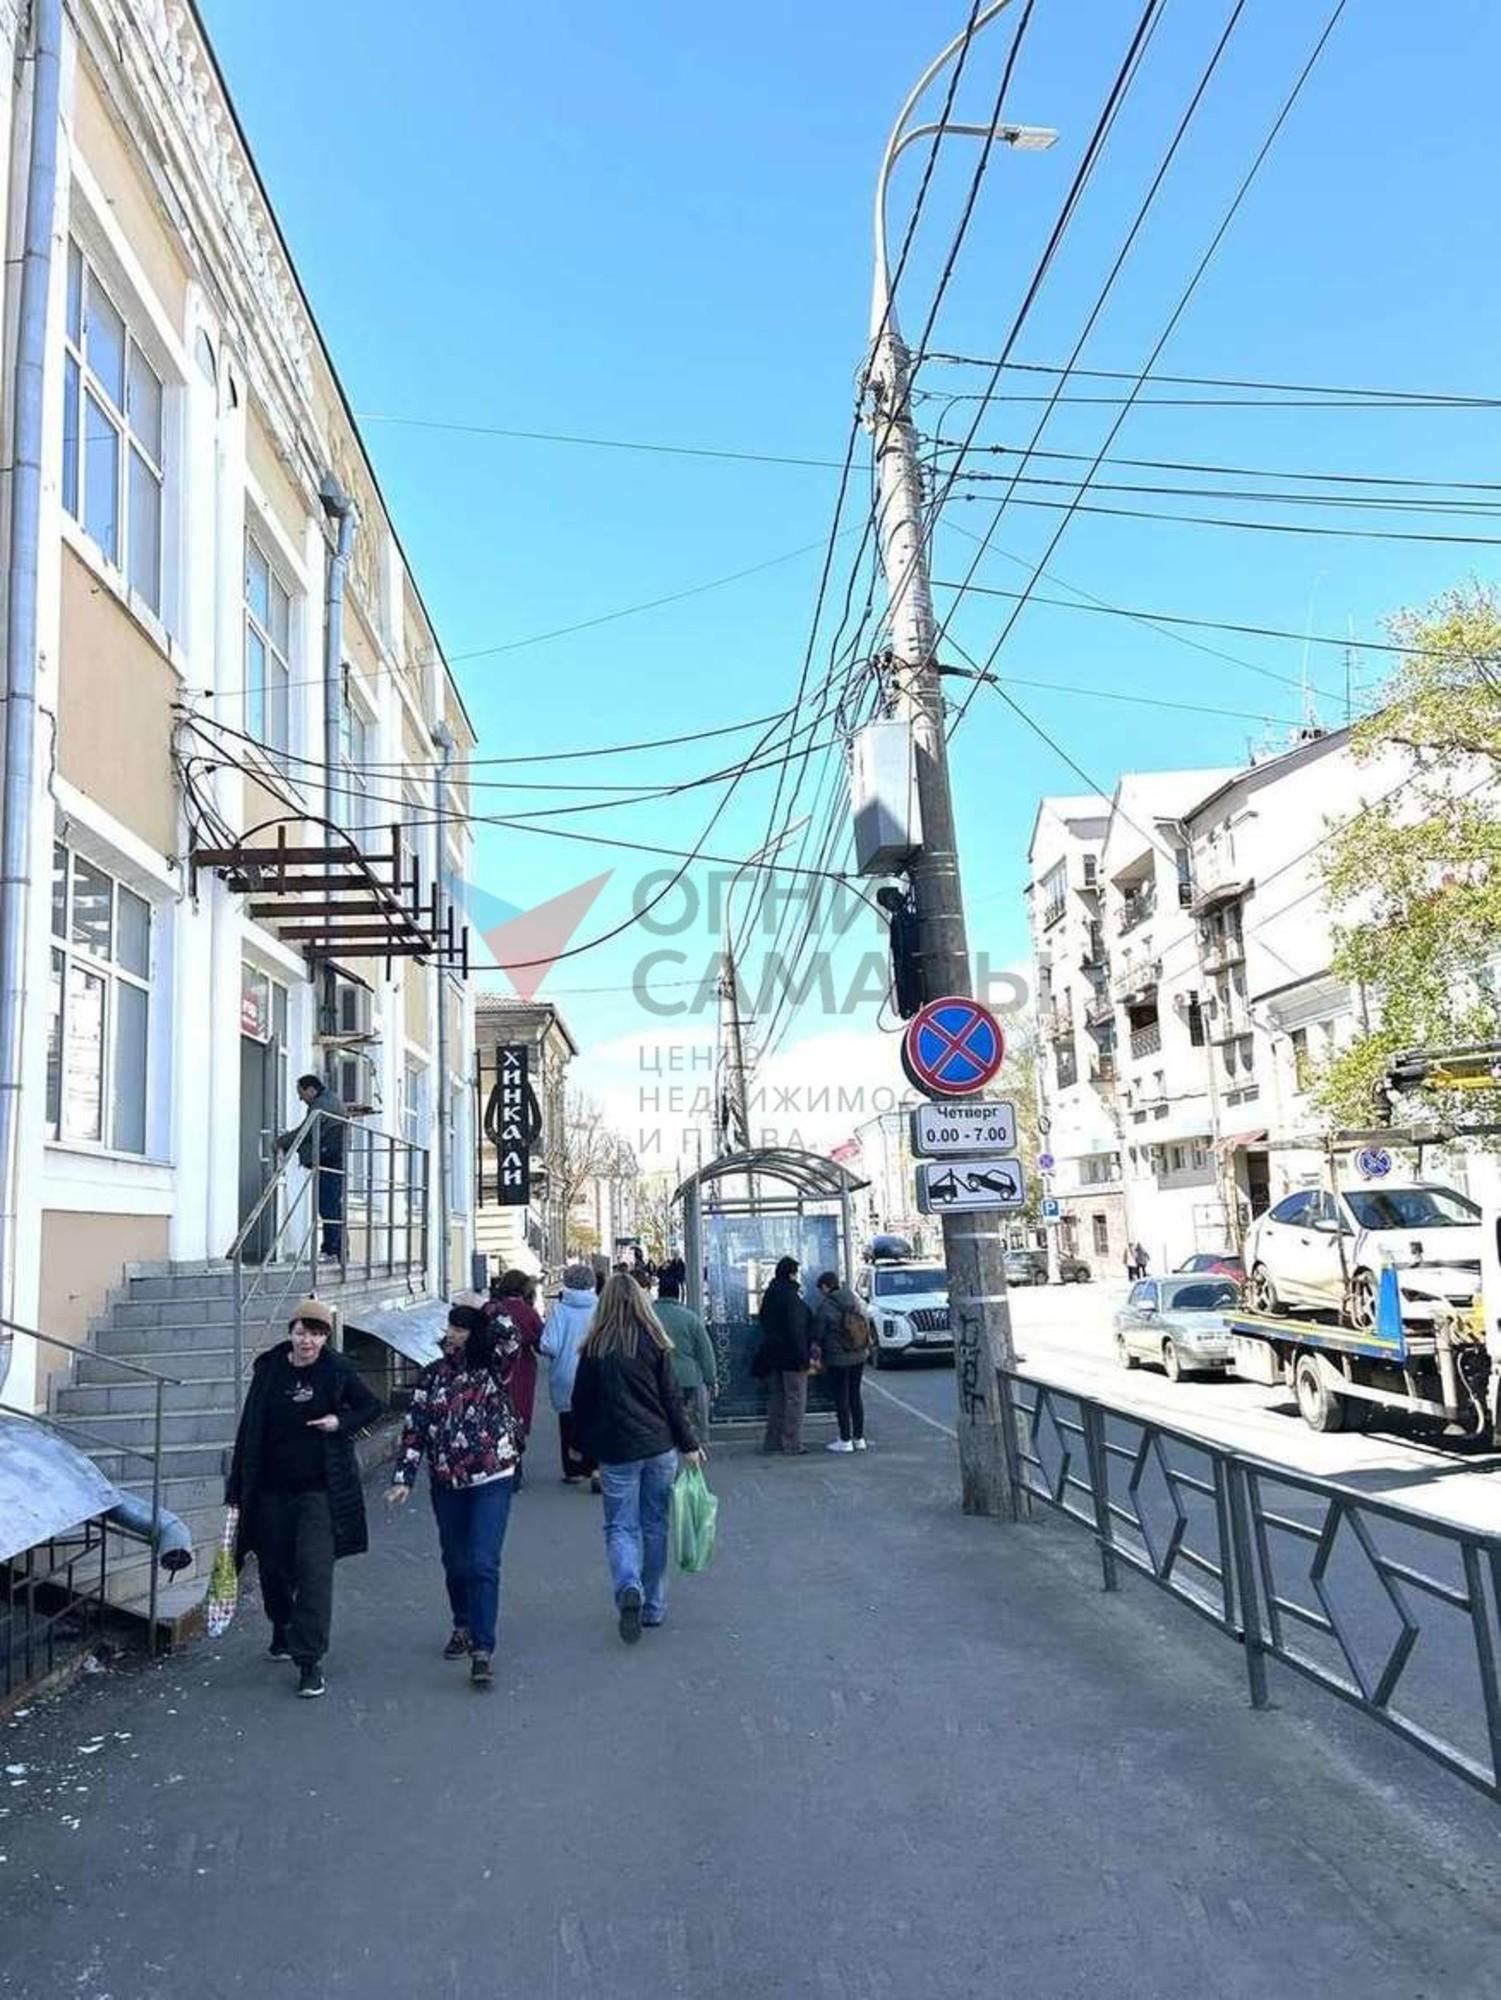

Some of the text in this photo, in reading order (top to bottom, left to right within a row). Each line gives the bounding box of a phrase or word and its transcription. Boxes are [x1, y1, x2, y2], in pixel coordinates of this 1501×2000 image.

[502, 1051, 522, 1185] ХИНКАЛИ
[937, 1107, 999, 1121] Четверг
[926, 1128, 959, 1143] 0.00
[973, 1127, 1007, 1142] 7.00
